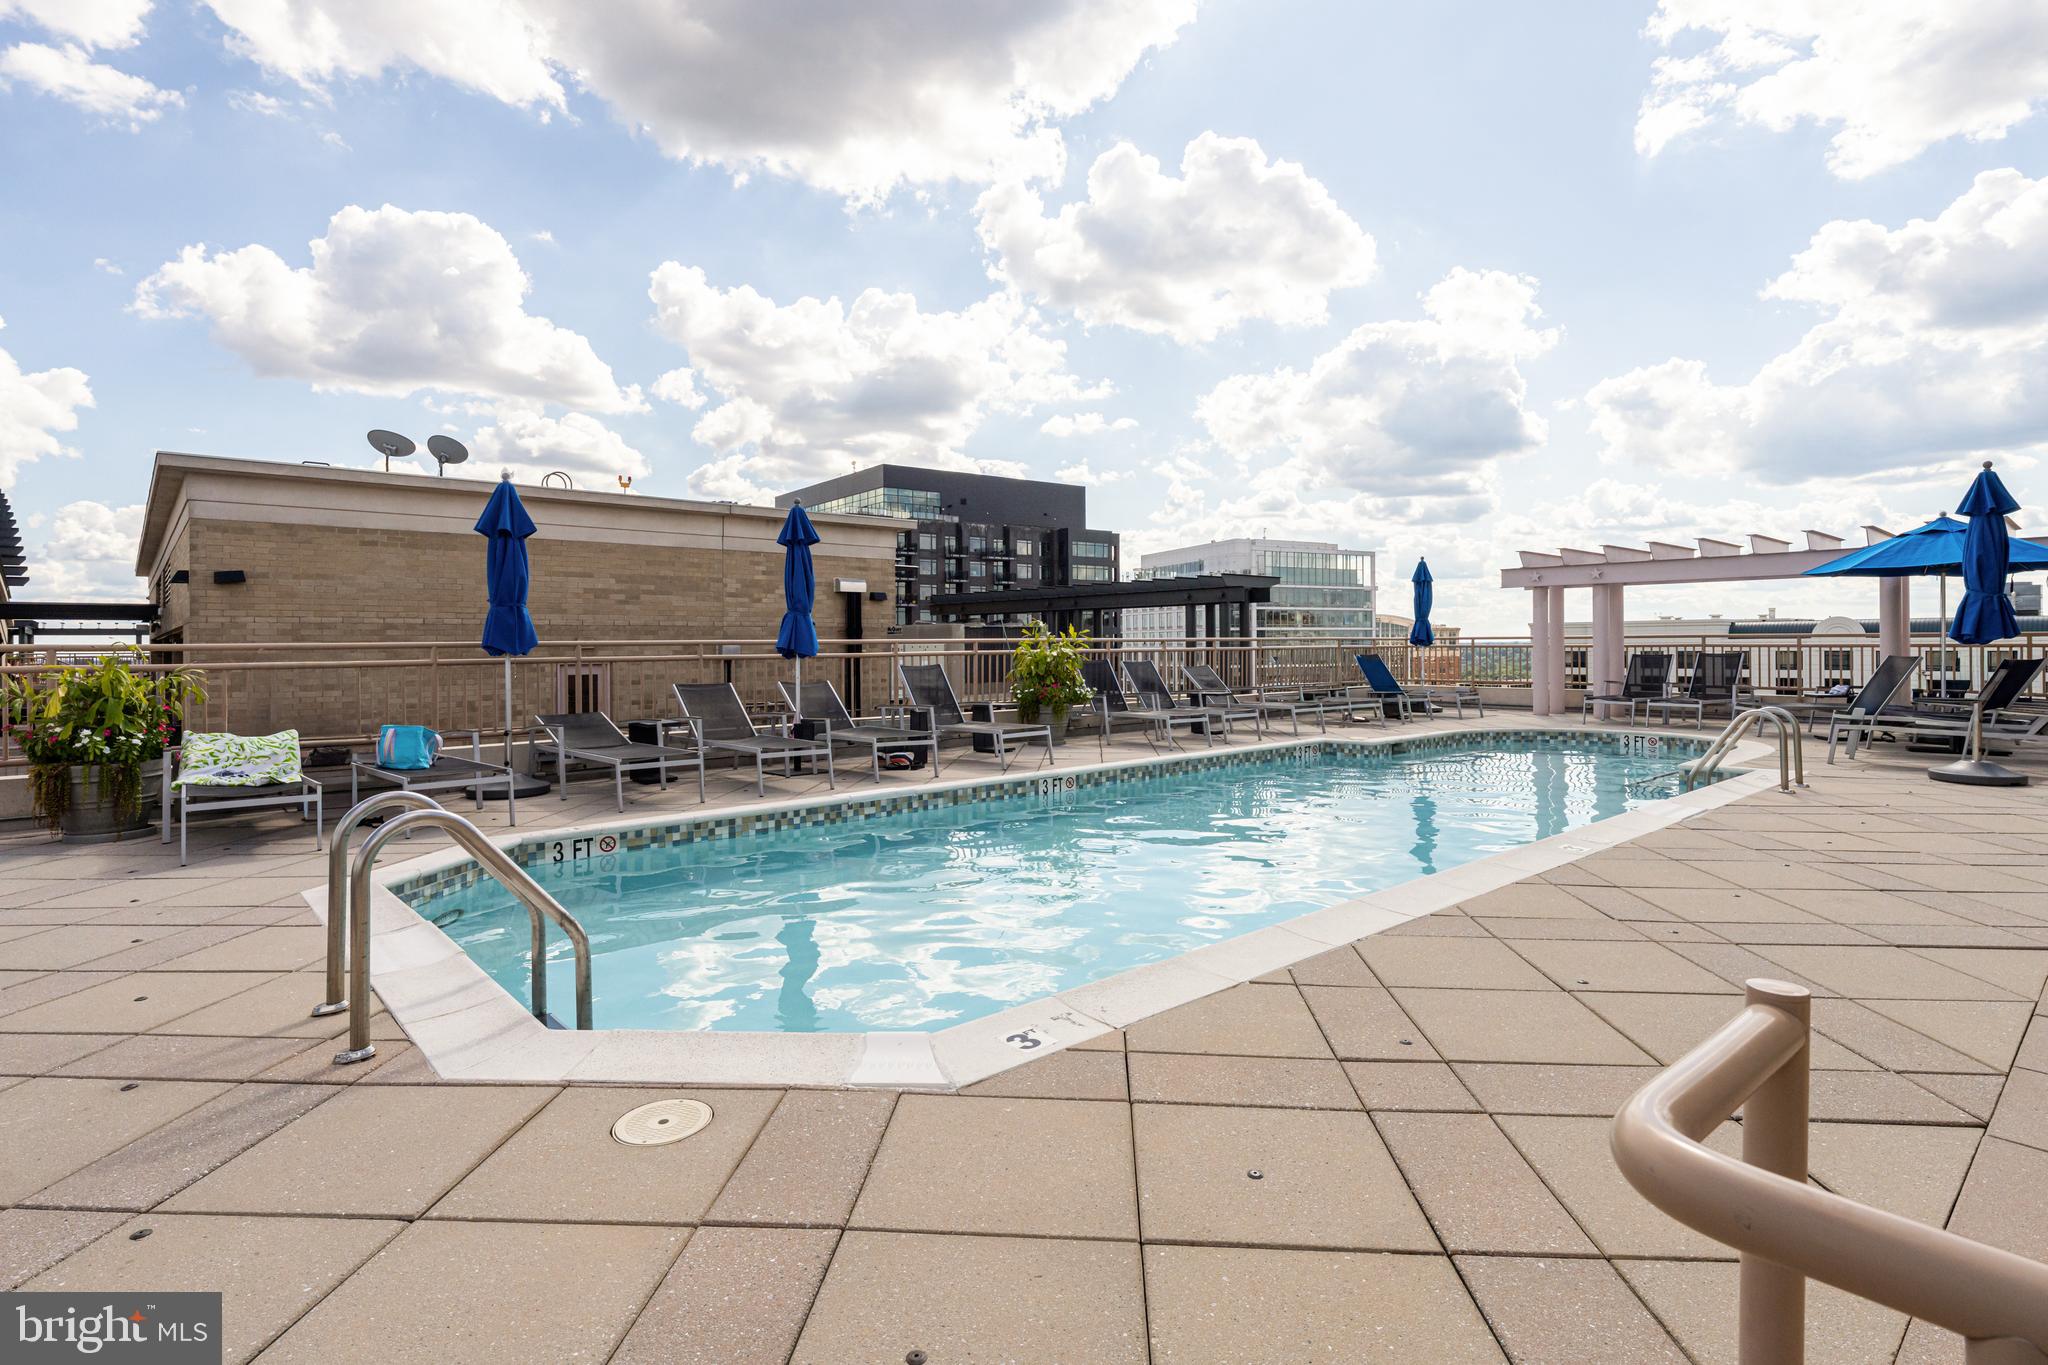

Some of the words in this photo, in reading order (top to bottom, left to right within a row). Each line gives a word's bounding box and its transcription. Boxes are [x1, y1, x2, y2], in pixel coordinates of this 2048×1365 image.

[1623, 734, 1630, 746] 3
[1634, 735, 1646, 748] FT
[1042, 779, 1049, 794] 3
[1052, 777, 1064, 793] FT
[553, 841, 564, 863] 3
[572, 837, 594, 860] FT
[1006, 1033, 1042, 1050] 3
